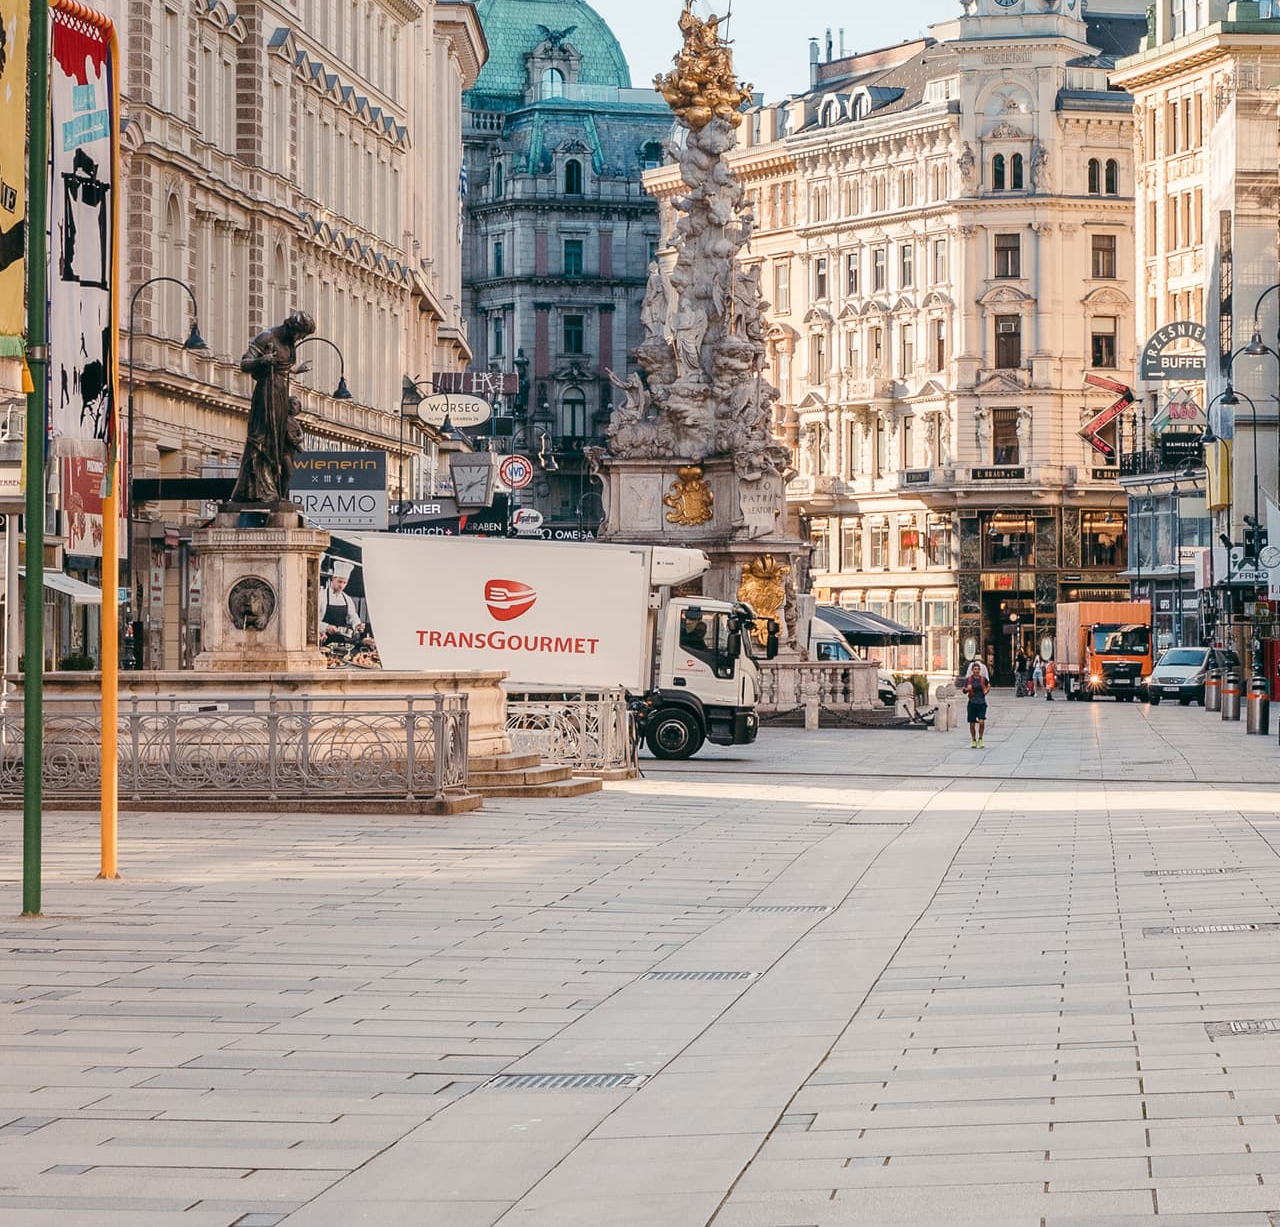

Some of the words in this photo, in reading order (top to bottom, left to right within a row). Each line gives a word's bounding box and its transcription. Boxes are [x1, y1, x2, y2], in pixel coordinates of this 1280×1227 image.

[1146, 324, 1206, 366] TRZEŚNIE
[428, 403, 480, 413] WORSEG
[293, 459, 377, 470] wienerin
[465, 522, 502, 531] GRABEN
[554, 530, 595, 540] OMEGA
[415, 630, 600, 654] TRANSGOURMET
